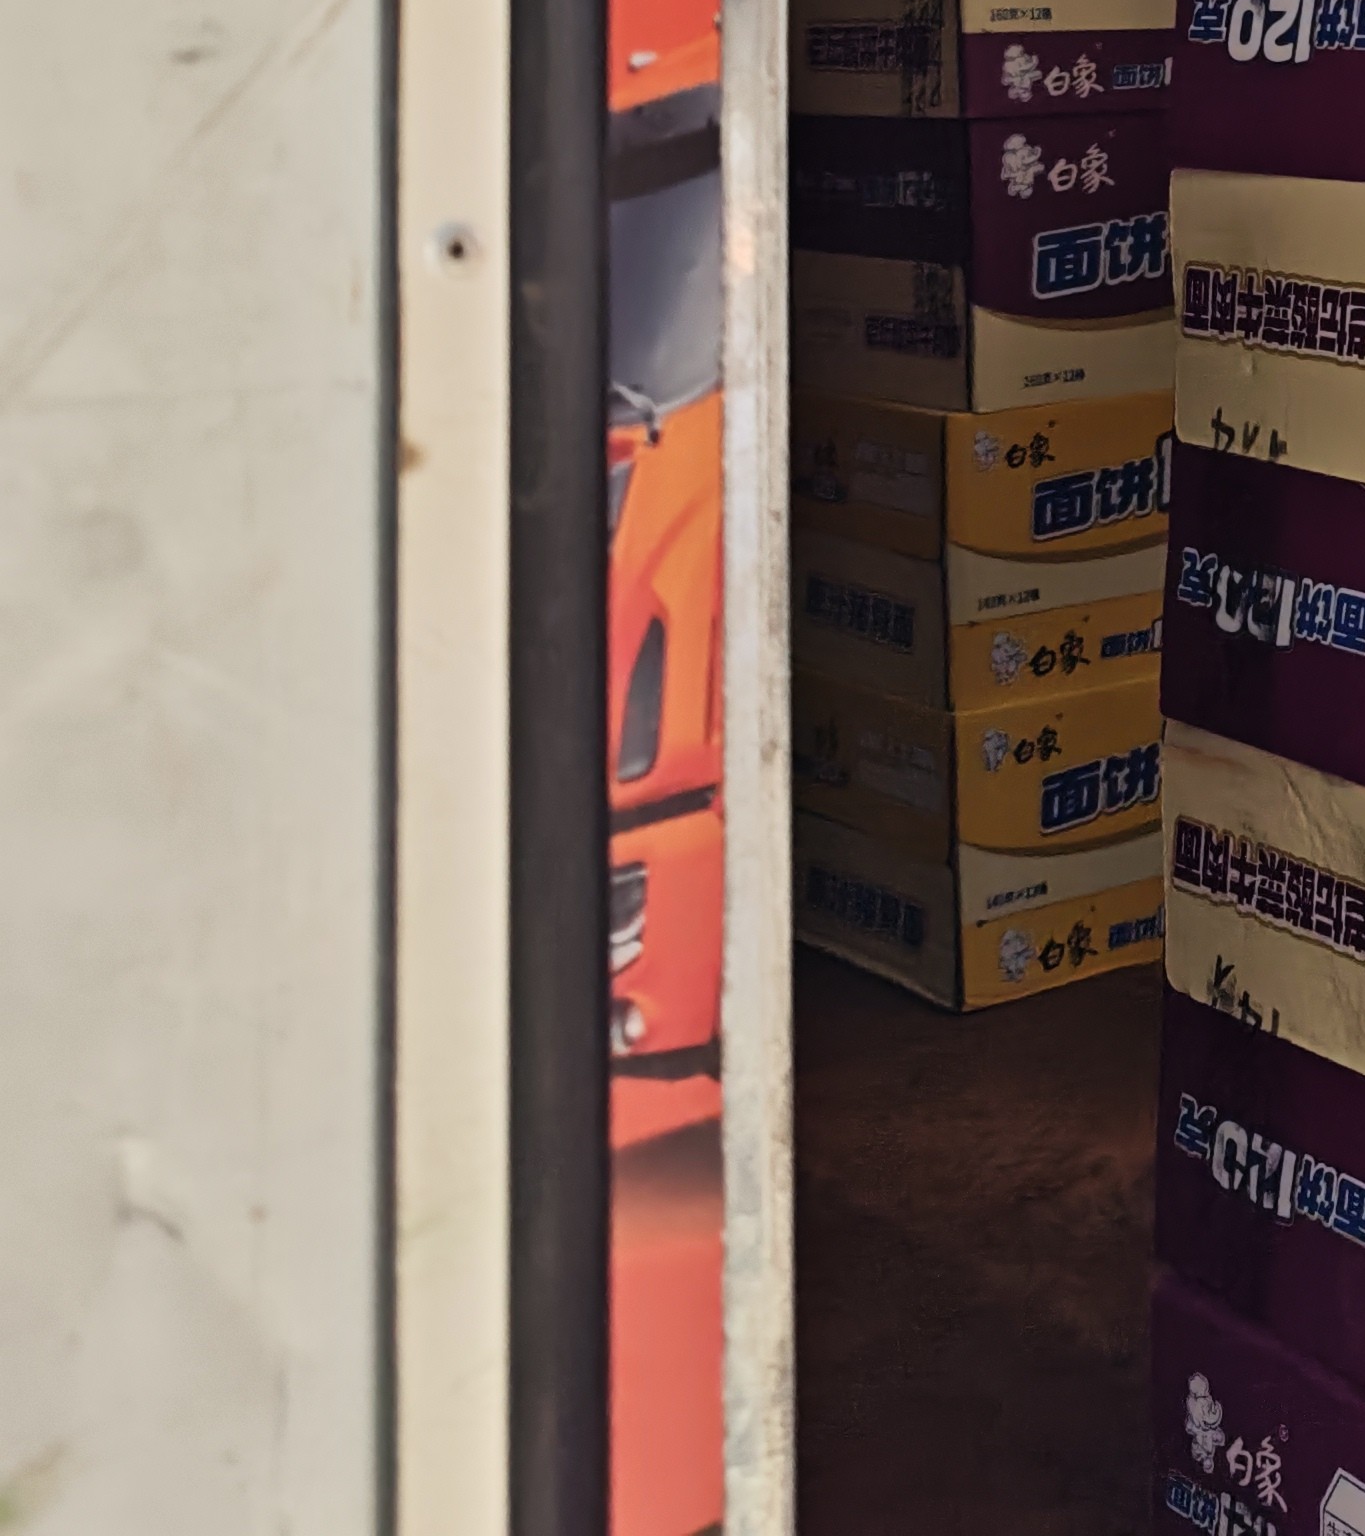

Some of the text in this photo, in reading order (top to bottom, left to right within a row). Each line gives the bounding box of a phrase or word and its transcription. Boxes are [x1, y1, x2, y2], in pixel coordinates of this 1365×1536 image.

[1043, 52, 1105, 99] 白象
[1048, 144, 1116, 194] 白象
[1005, 431, 1056, 469] 白象
[1026, 629, 1092, 677] 白象
[1012, 724, 1063, 764] 白象
[1038, 919, 1099, 973] 白象
[1226, 1436, 1288, 1514] 白象
